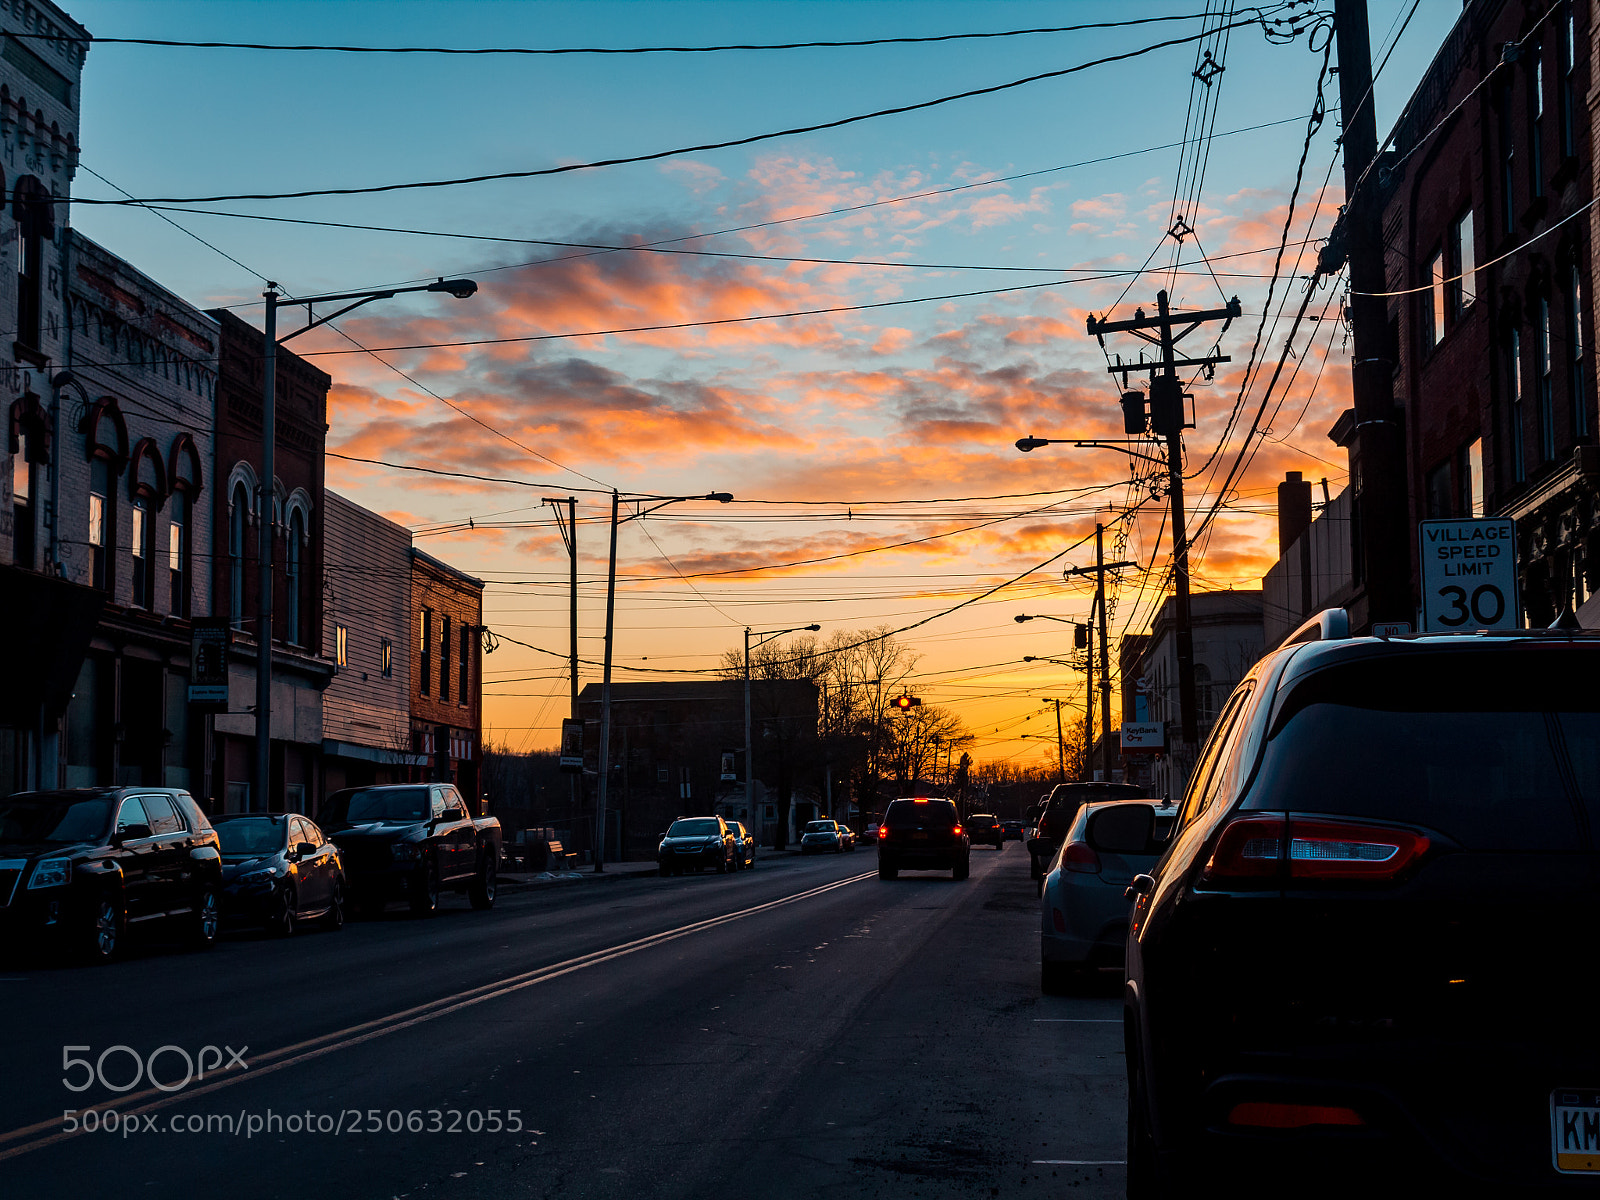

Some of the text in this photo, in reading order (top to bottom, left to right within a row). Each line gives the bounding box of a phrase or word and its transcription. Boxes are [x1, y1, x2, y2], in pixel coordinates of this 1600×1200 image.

[1427, 526, 1510, 542] VILLAGE
[1437, 545, 1500, 560] SPEED
[1445, 562, 1494, 576] LIMIT
[1438, 584, 1505, 627] 30
[1384, 627, 1399, 636] NO
[1126, 727, 1158, 735] KeyBank
